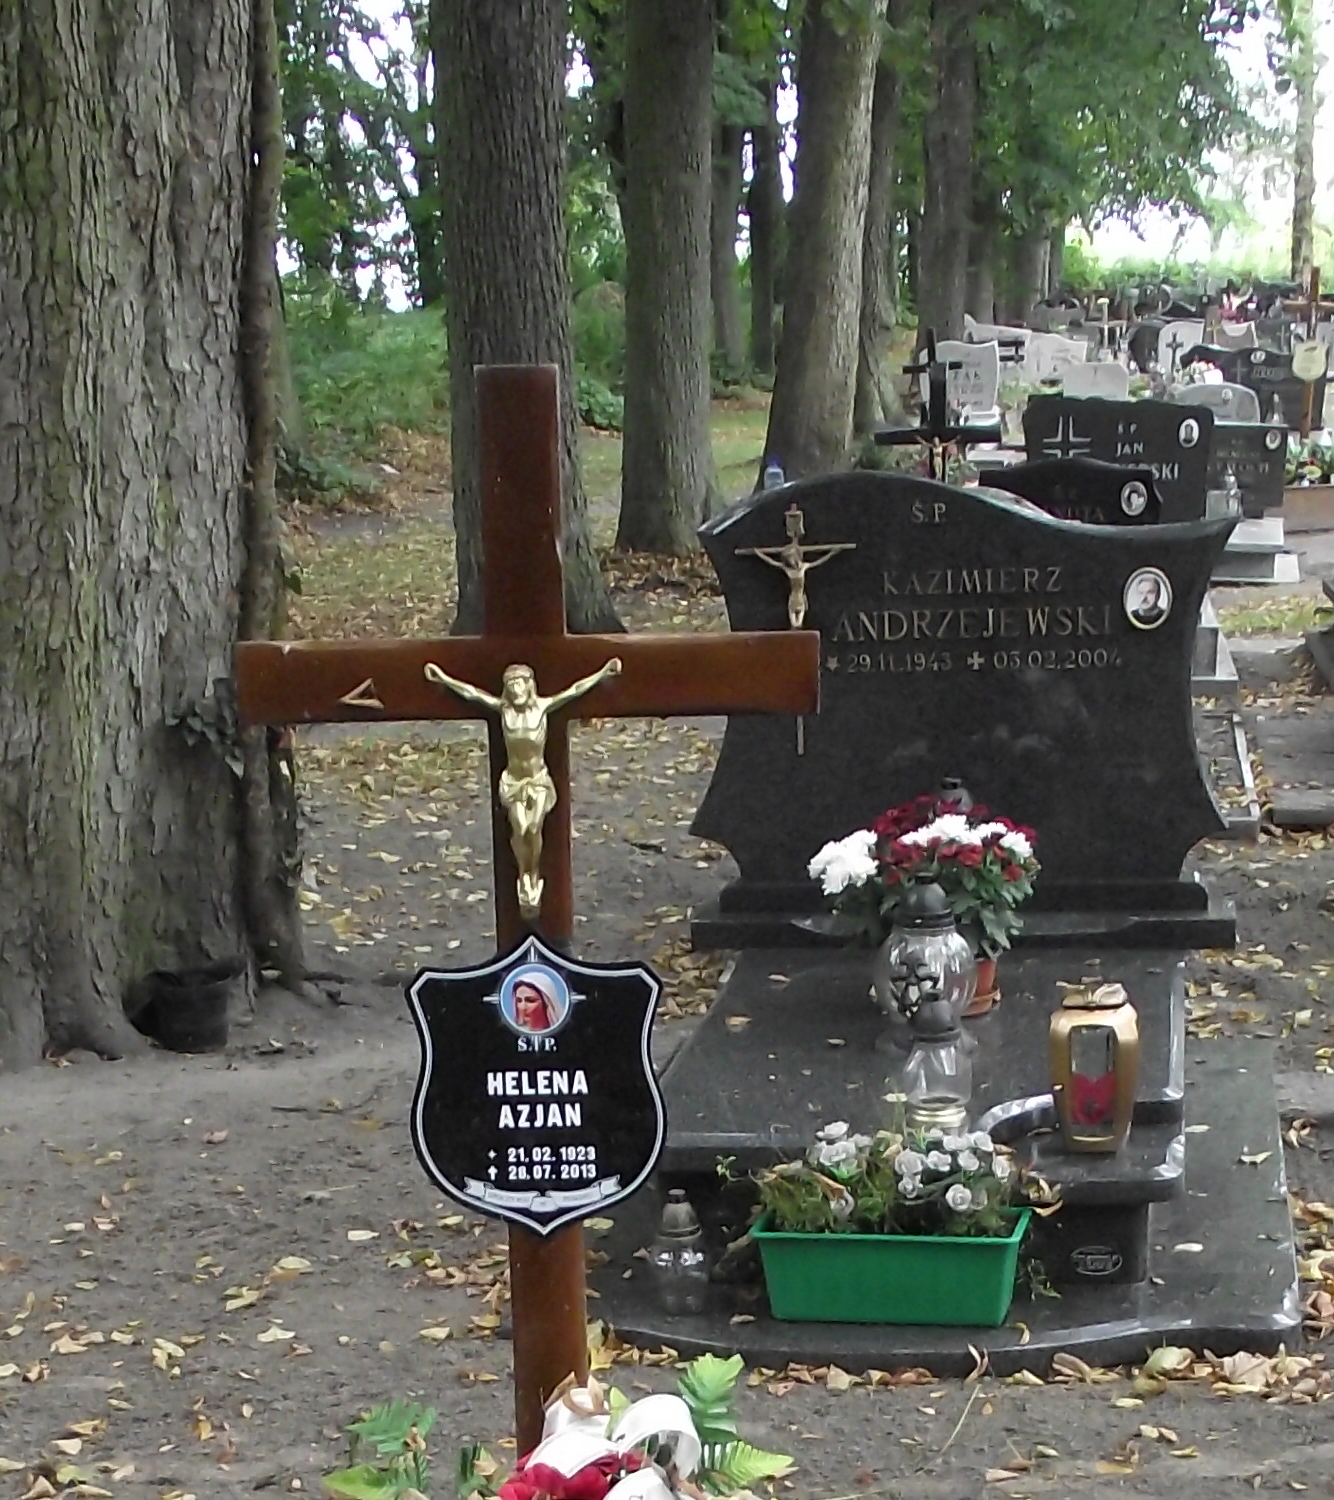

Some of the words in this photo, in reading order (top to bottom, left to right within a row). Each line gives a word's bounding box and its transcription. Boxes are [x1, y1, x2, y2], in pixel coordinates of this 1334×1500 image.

[1116, 442, 1144, 457] JAN
[881, 566, 1063, 596] KAZIMIERZ
[830, 606, 1113, 642] ANDRZEJEWSKI
[487, 1070, 589, 1096] HELENA
[498, 1103, 582, 1129] AZJAN
